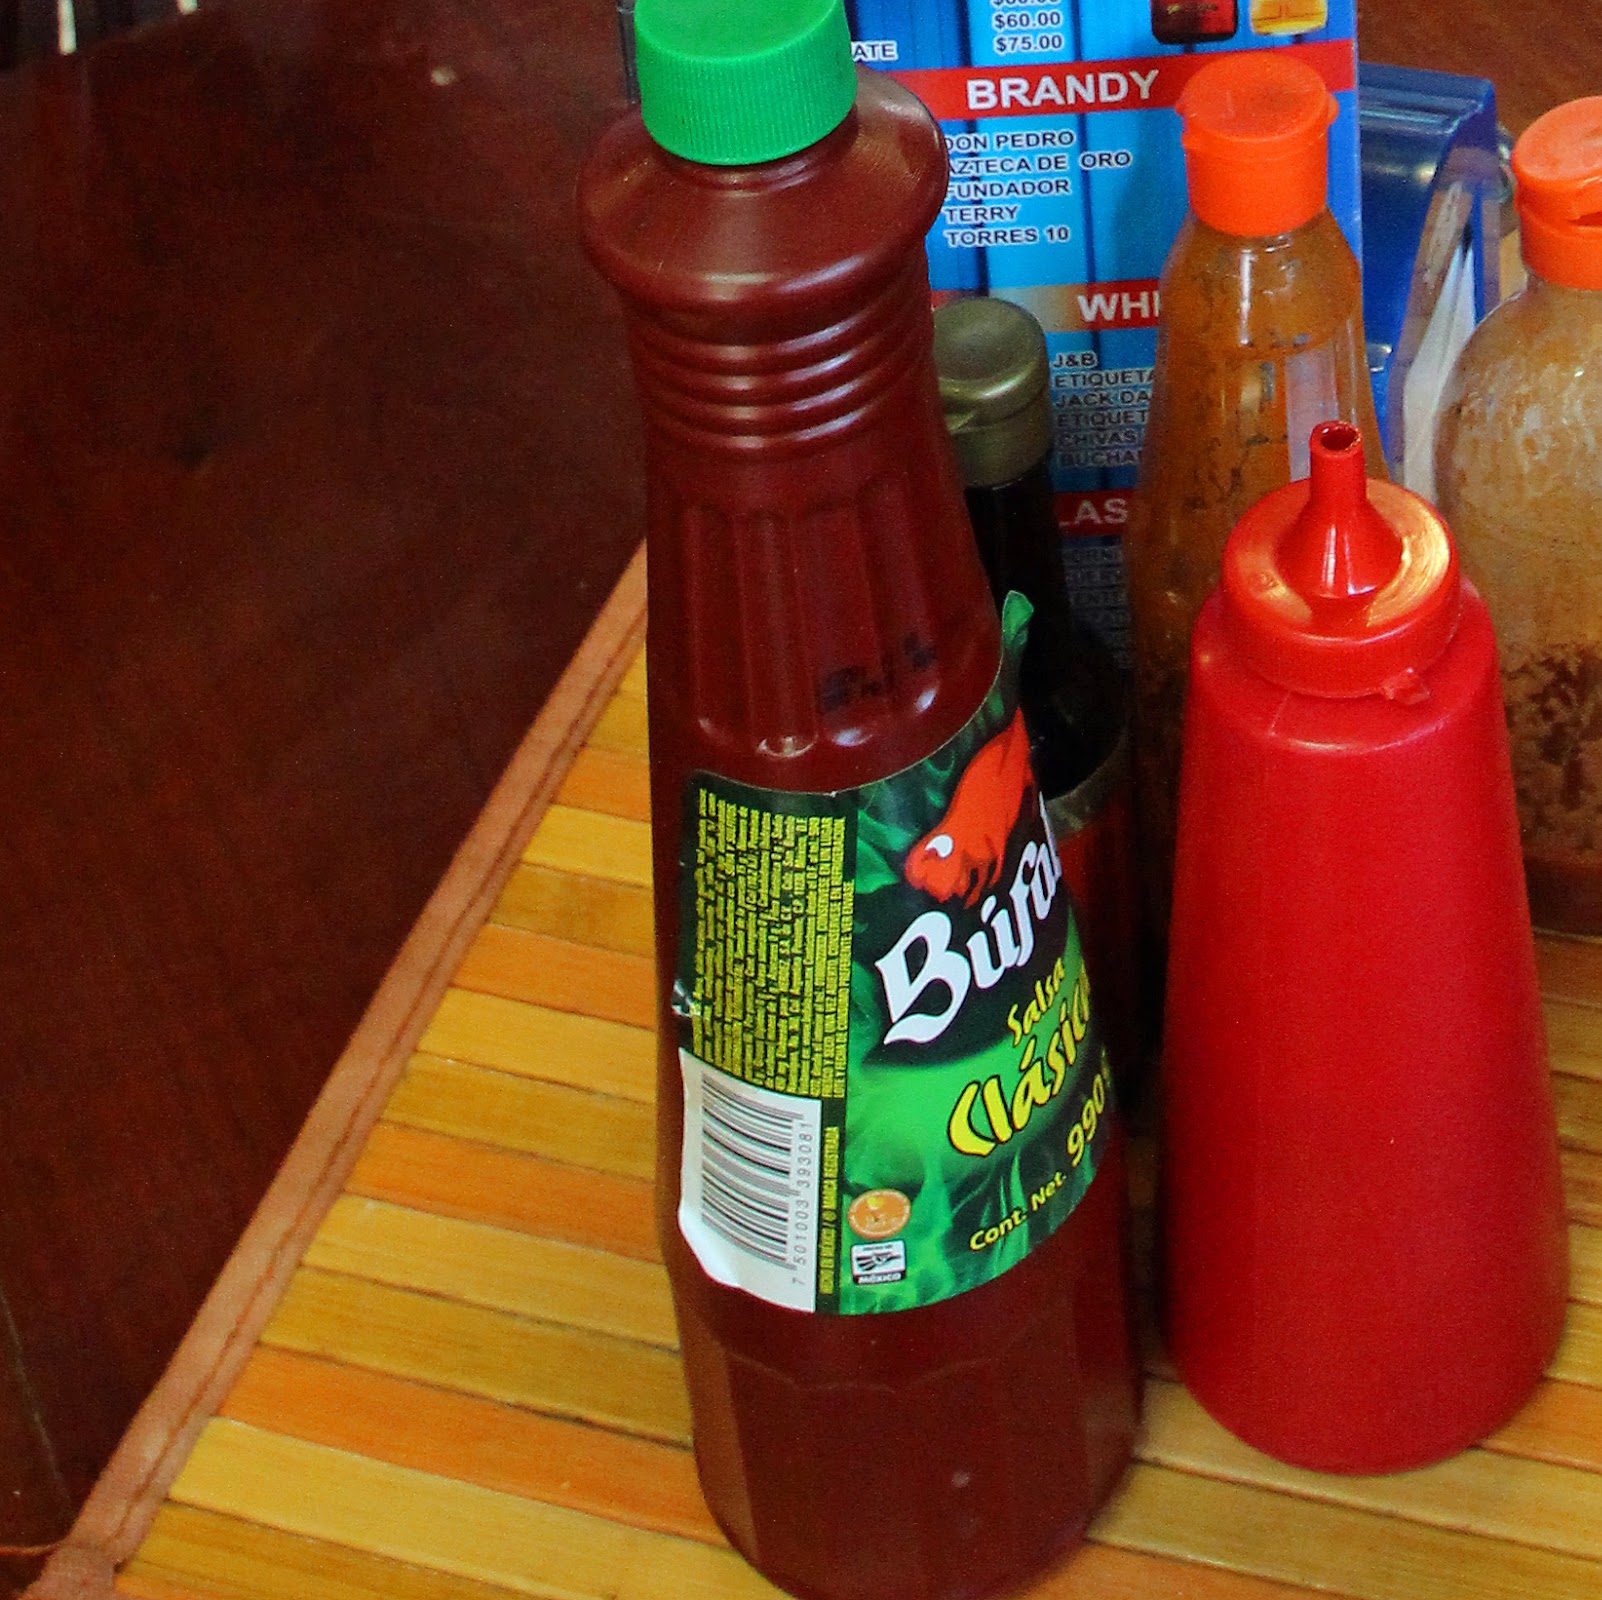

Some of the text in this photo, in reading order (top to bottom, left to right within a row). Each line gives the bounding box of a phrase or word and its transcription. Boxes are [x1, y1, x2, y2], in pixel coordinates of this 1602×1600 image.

[992, 10, 1063, 31] $60.00
[851, 33, 1063, 62] ATE $75.00
[966, 69, 1159, 111] BRANDY
[944, 130, 1076, 151] DON PEDRO
[949, 151, 1132, 175] AZTECA DE ORO
[947, 179, 1071, 201] FUNDADOR
[943, 205, 1020, 225] TERRY
[944, 226, 1071, 248] TORRES 10
[1077, 291, 1161, 323] WHI
[1052, 350, 1098, 369] J&B
[1056, 388, 1151, 408] JACK DA
[1057, 409, 1149, 428] ETIQUET
[1060, 449, 1142, 467] BUCHA
[875, 791, 1062, 1045] Búfal
[1007, 957, 1066, 1046] Salsa
[970, 1207, 1027, 1250] Cont.
[1031, 1171, 1067, 1211] Net.
